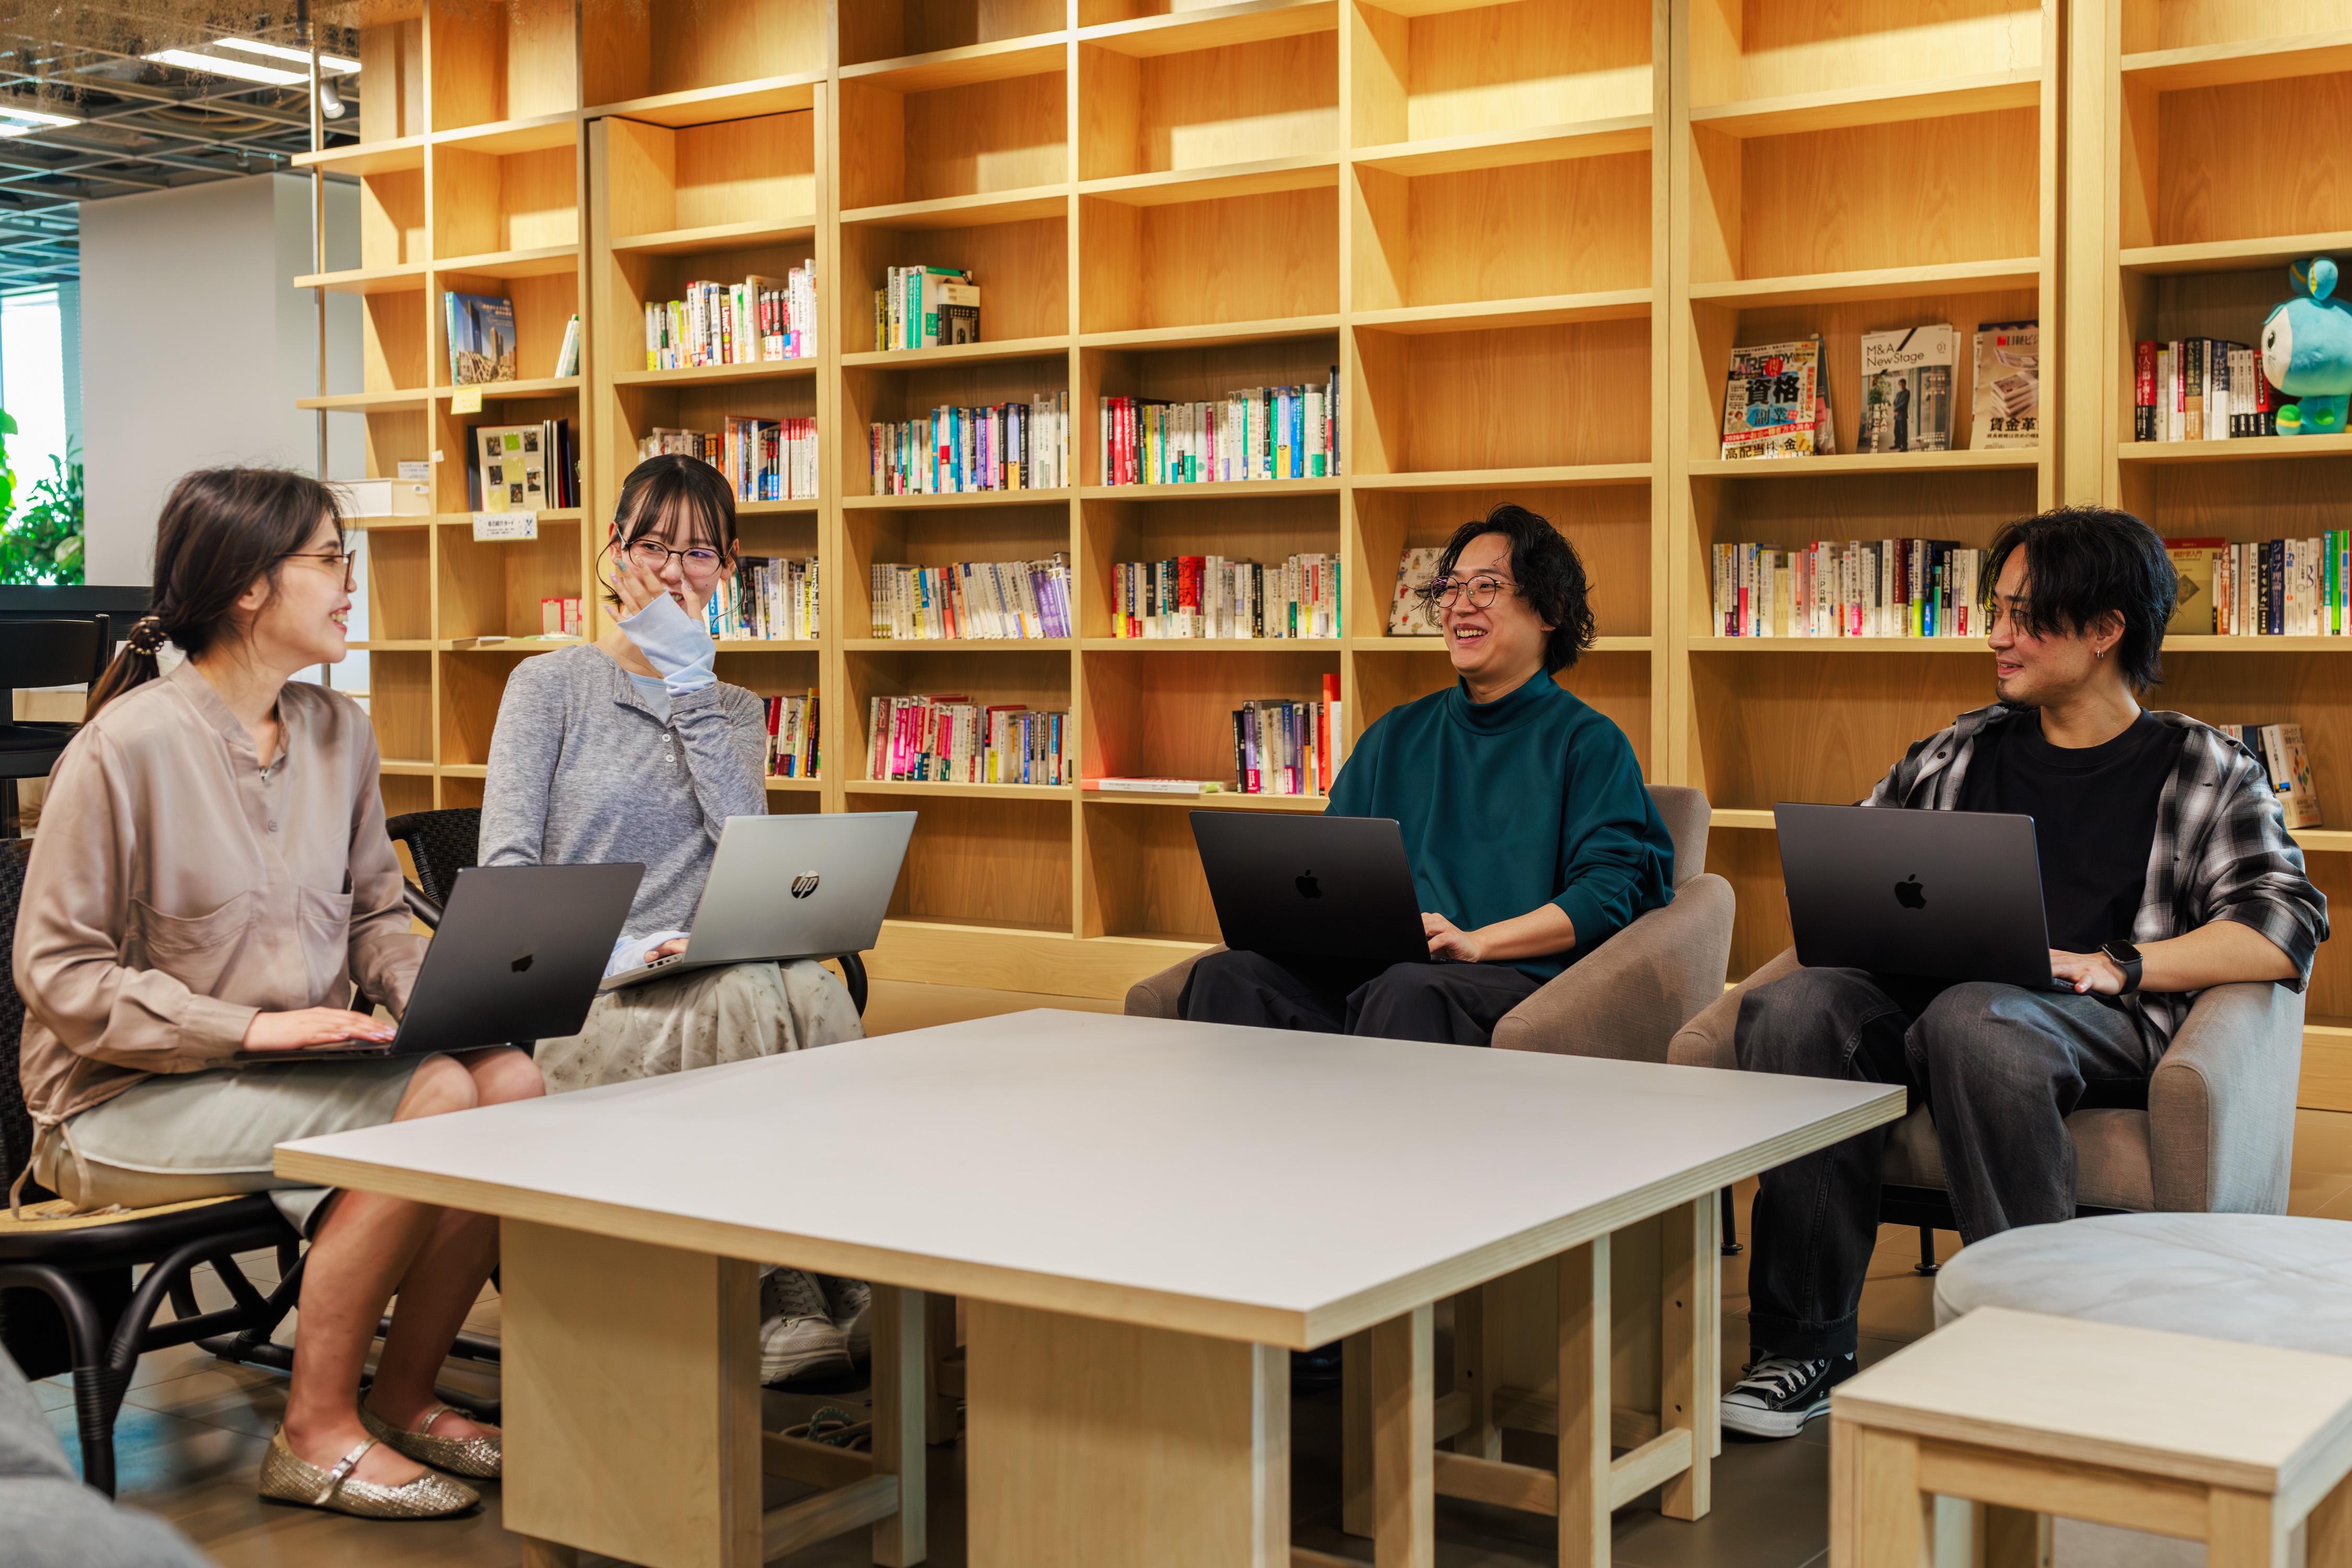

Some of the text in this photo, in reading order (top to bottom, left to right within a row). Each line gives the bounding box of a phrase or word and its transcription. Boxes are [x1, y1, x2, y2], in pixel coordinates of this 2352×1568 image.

[1866, 343, 1895, 356] M&A
[1734, 352, 1794, 374] TREDY
[1745, 374, 1800, 406] 資格
[1755, 408, 1788, 425] 副業
[1990, 417, 2039, 432] 賃金革
[2272, 543, 2282, 591] ジョブ理論
[792, 870, 819, 899] hp
